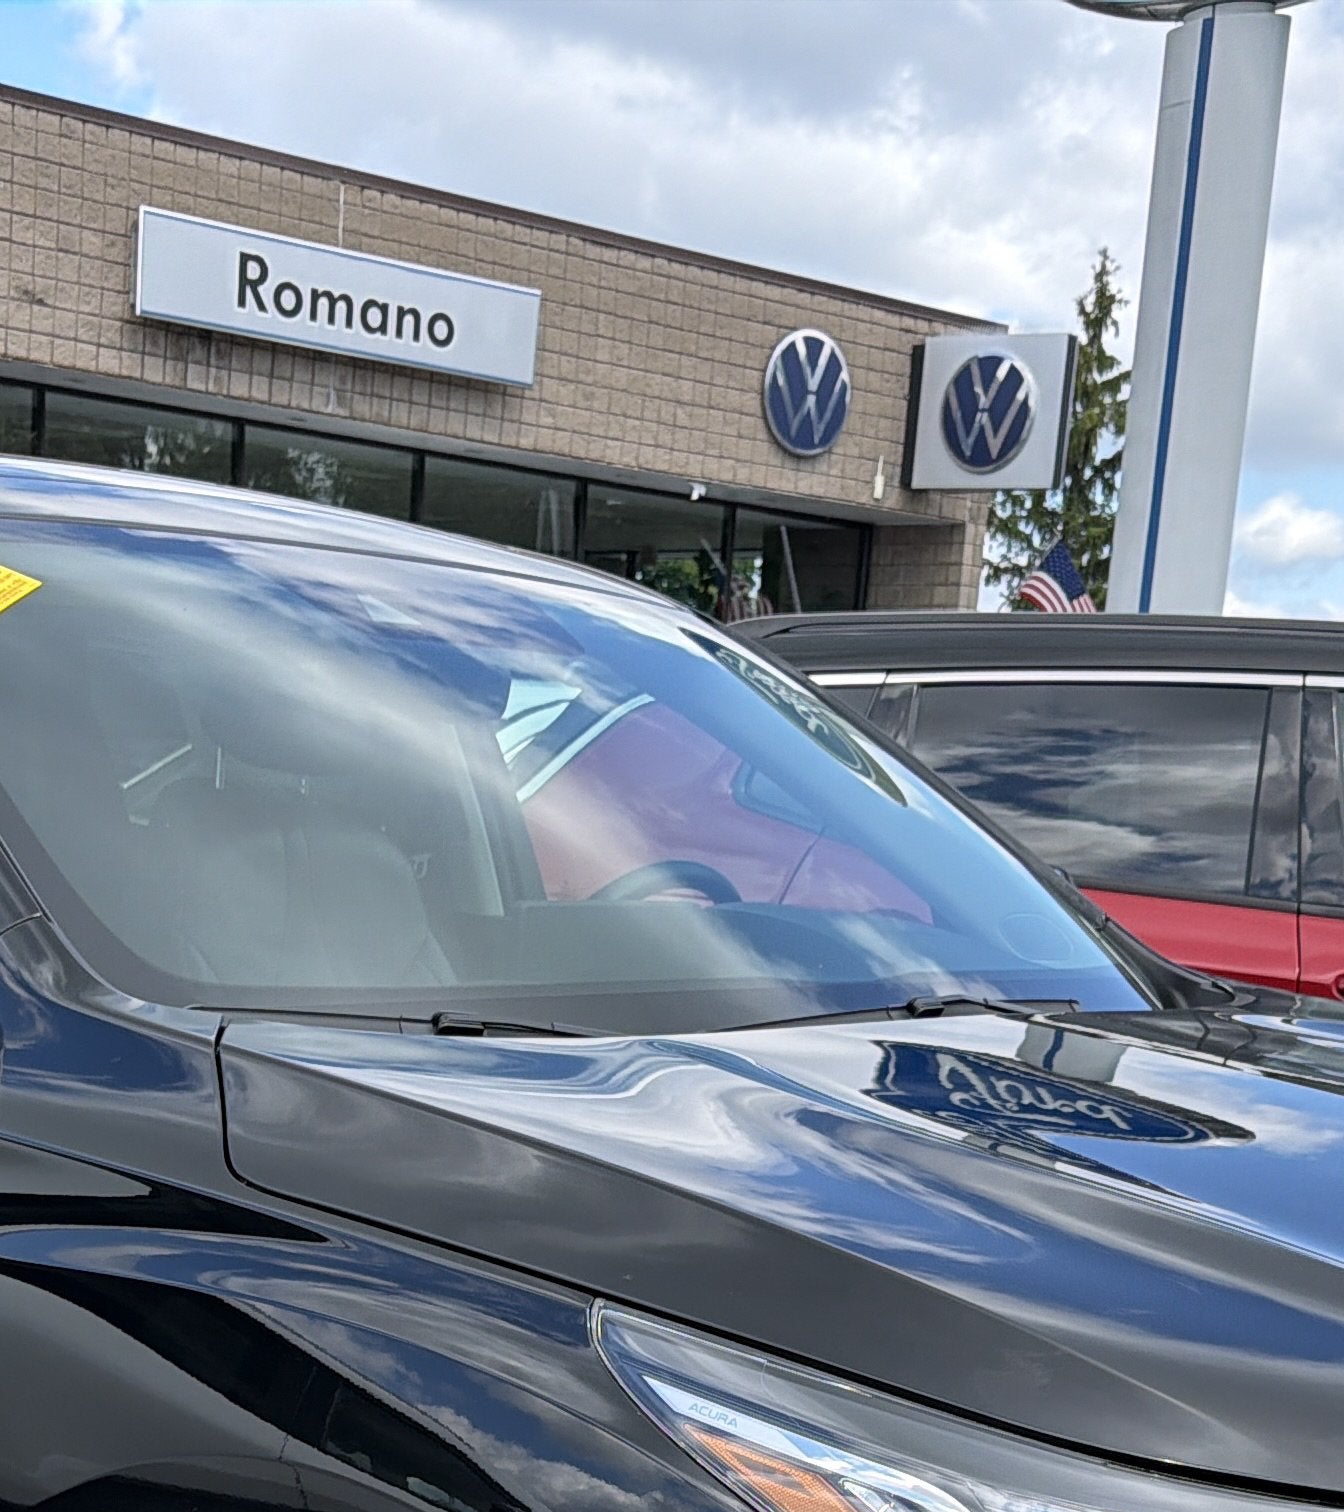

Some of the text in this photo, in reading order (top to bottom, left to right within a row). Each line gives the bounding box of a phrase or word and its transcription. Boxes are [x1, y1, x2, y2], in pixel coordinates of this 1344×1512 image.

[236, 251, 456, 348] Romano
[766, 331, 851, 452] VW
[943, 352, 1037, 470] VW
